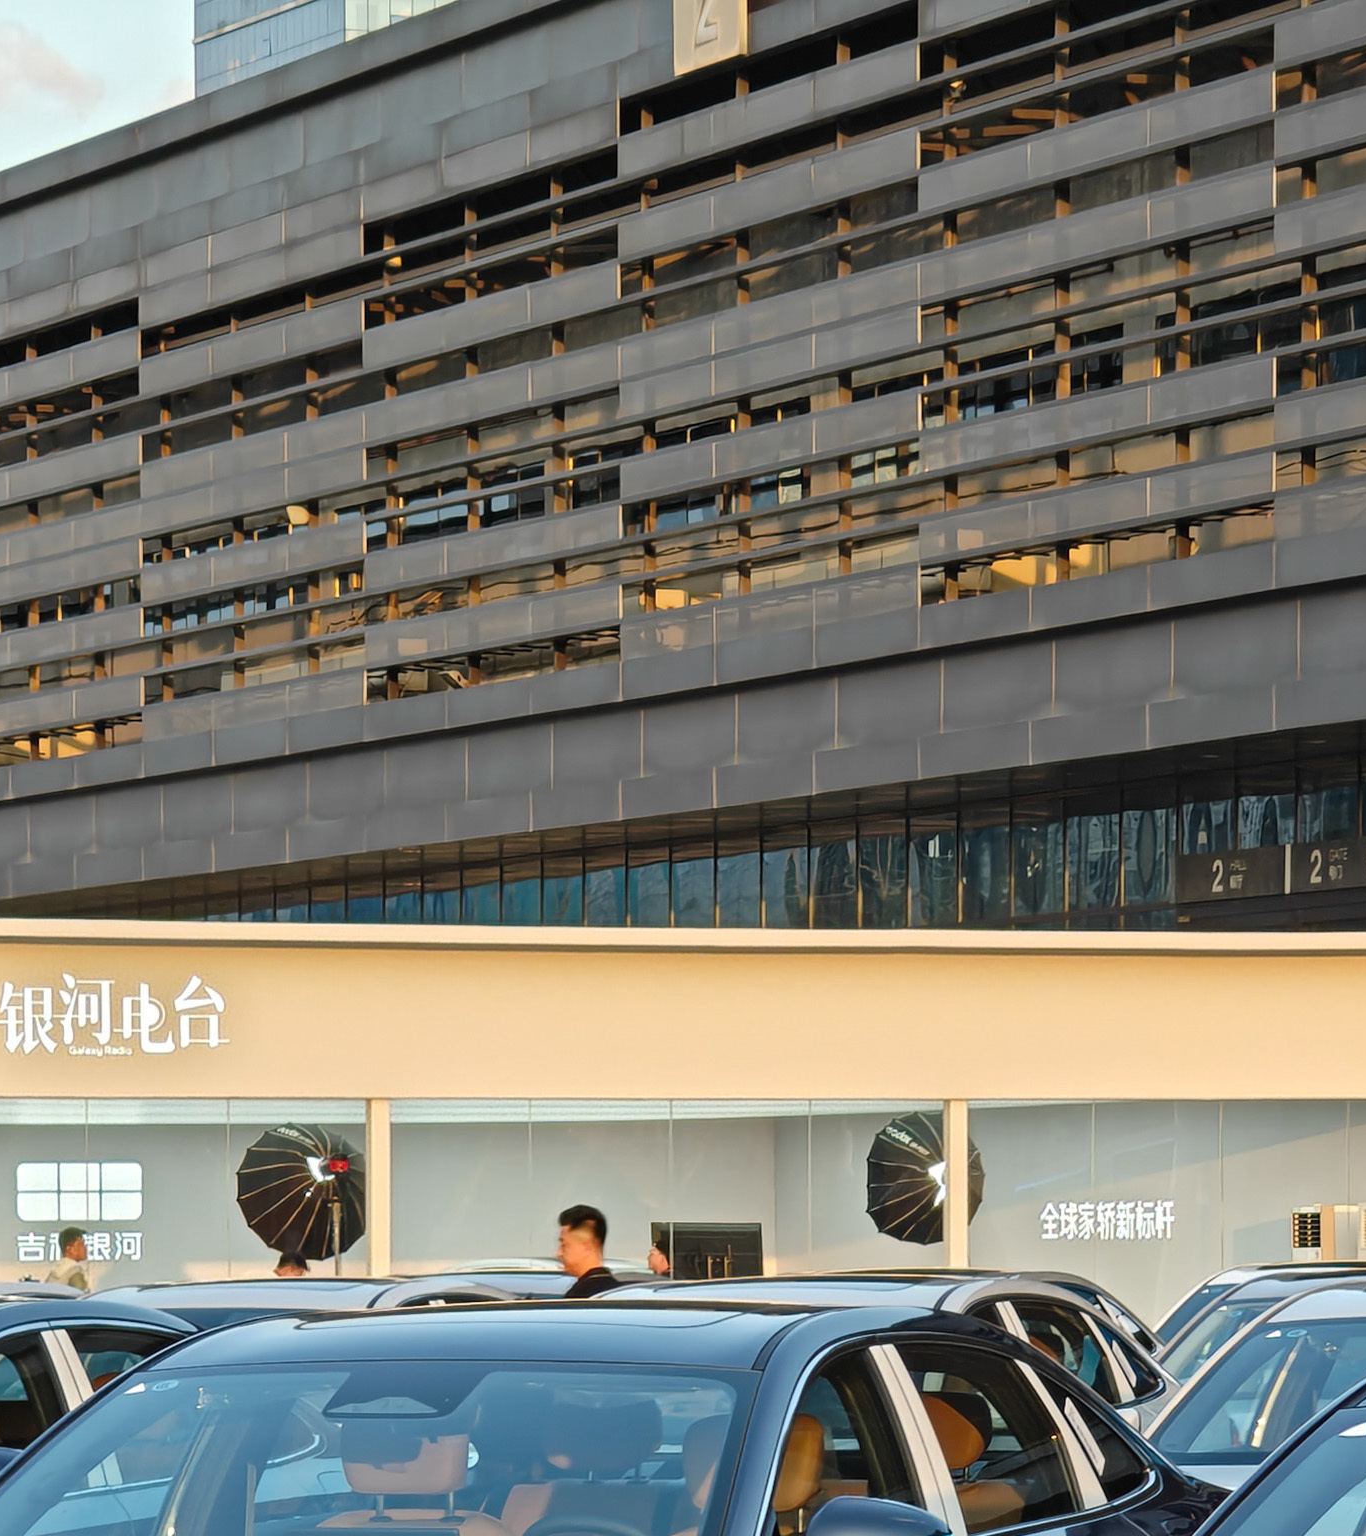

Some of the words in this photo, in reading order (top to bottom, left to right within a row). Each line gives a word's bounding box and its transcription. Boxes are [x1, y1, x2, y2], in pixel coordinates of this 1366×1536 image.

[1211, 859, 1224, 893] 2
[1310, 849, 1322, 884] 2
[68, 1045, 103, 1057] Galaxy
[104, 1045, 133, 1056] Radio
[1040, 1200, 1176, 1240] 全球家轿新标杆
